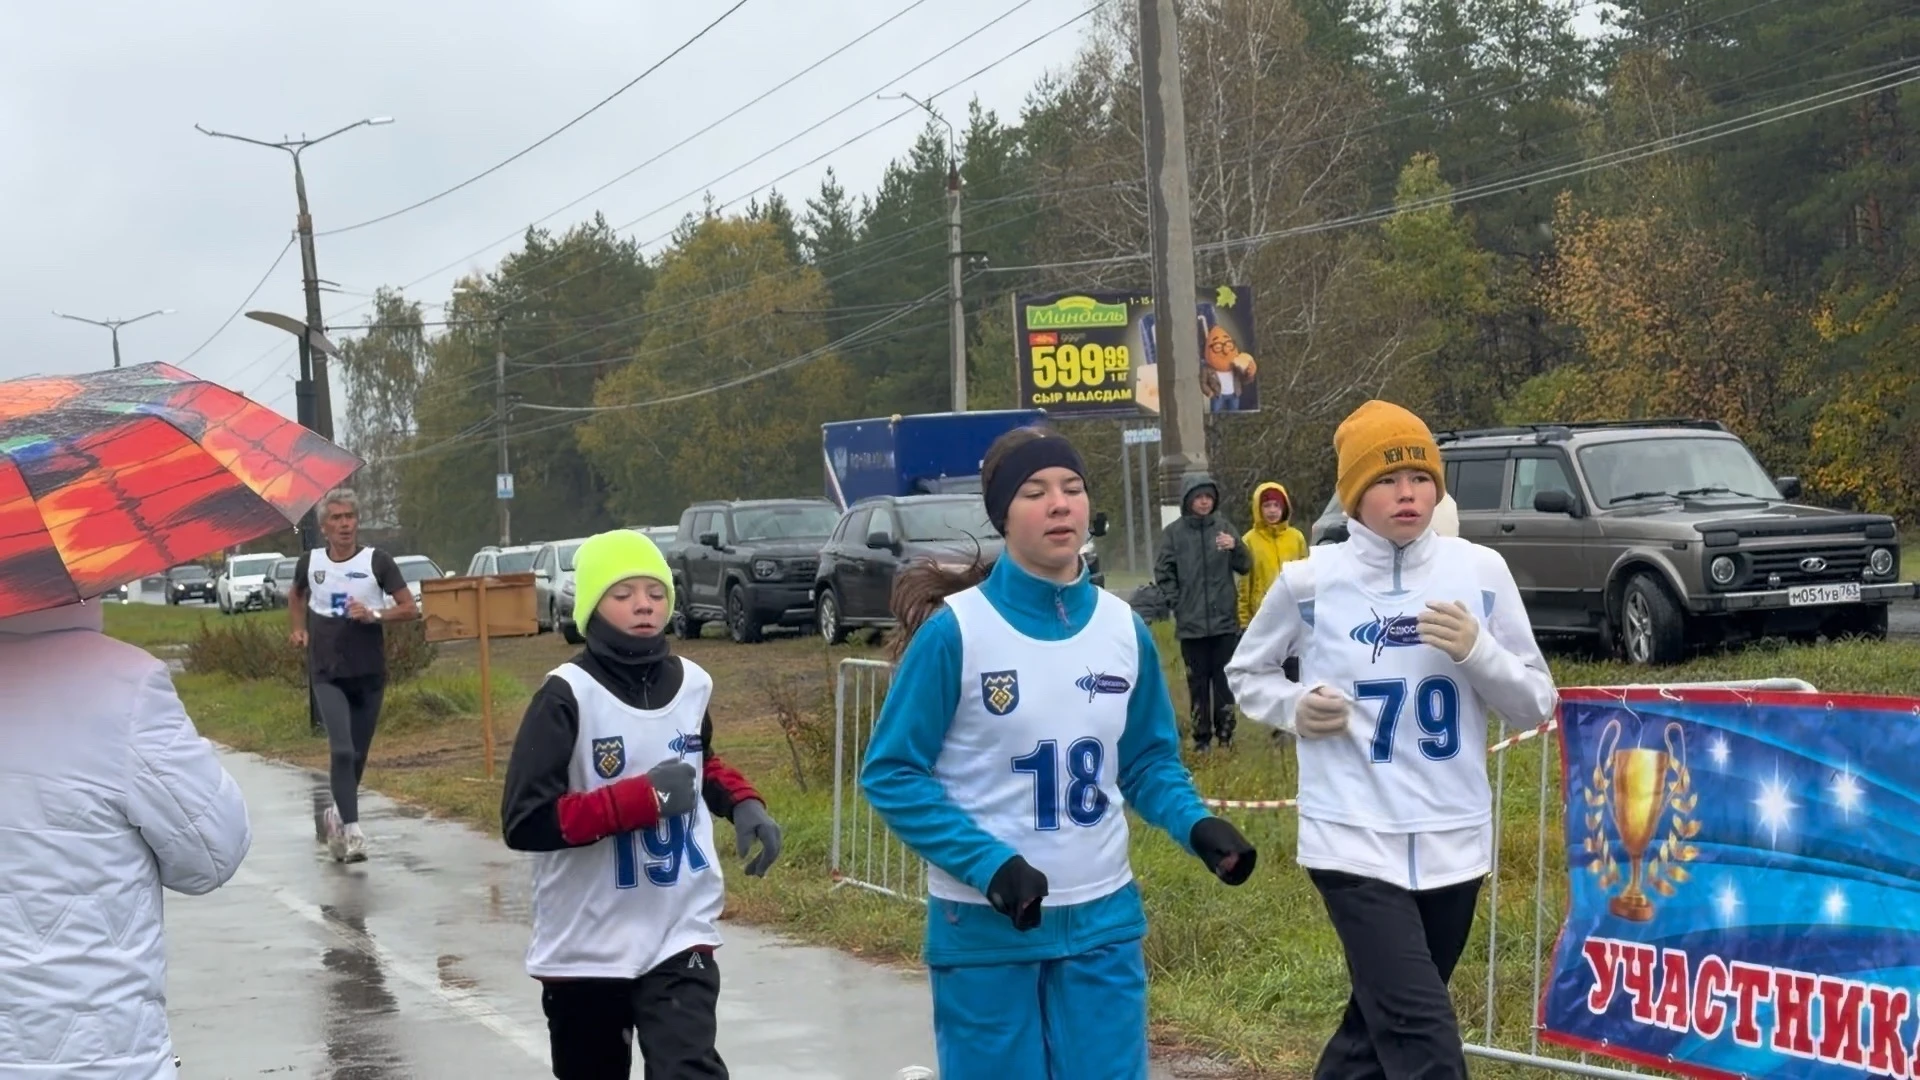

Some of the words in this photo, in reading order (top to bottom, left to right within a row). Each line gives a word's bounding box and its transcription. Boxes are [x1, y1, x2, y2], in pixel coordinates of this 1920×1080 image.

[1032, 309, 1124, 325] Миндаль
[1032, 344, 1105, 388] 599
[1032, 392, 1063, 404] СЫР
[1065, 388, 1132, 403] МААСДАМ
[1384, 447, 1403, 464] NEW
[1405, 446, 1427, 461] YORK
[1354, 674, 1461, 763] 79
[1011, 736, 1110, 831] 18
[1582, 936, 1920, 1080] УЧАСТНИК
